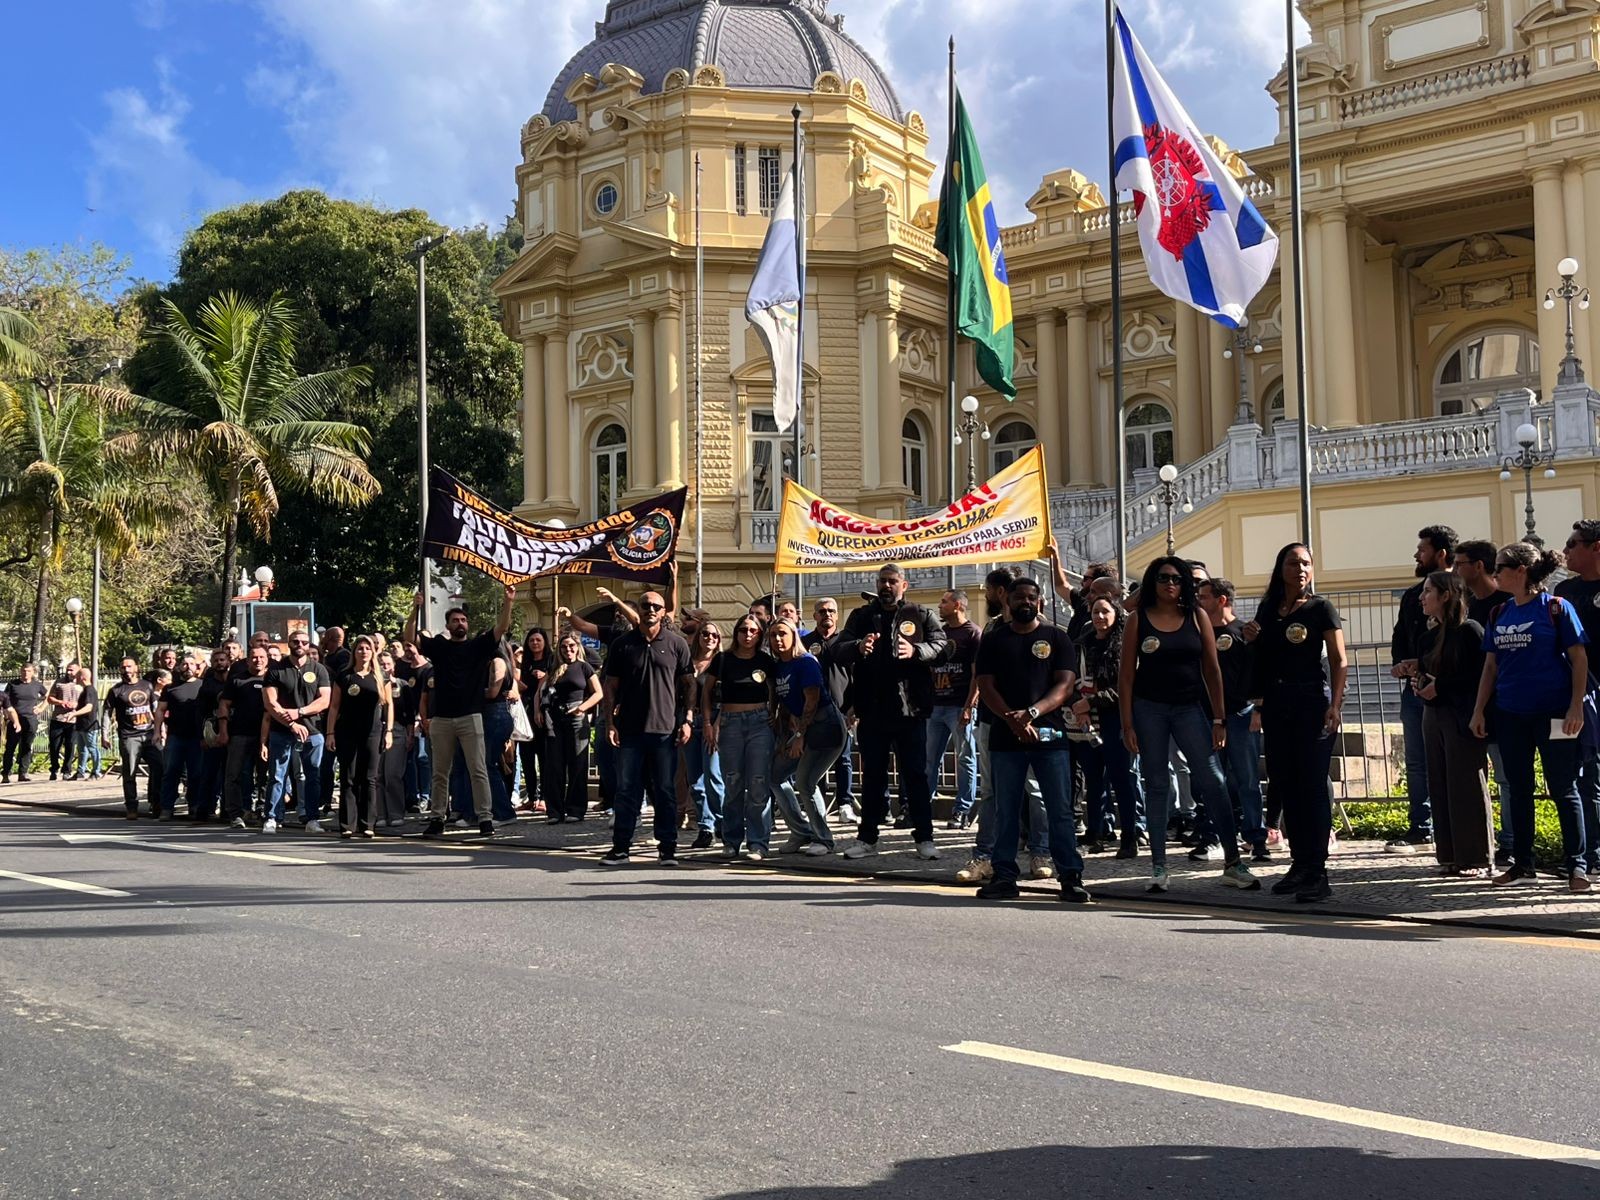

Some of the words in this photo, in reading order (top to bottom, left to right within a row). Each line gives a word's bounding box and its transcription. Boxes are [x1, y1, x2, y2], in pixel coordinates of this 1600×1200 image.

[453, 501, 511, 546] FALTA
[818, 530, 896, 549] QUEREMOS
[900, 501, 1000, 542] TRABALHAR!
[865, 545, 923, 558] APROVADOS
[973, 527, 1001, 541] PARA
[1002, 516, 1038, 533] SERVIR
[985, 540, 998, 551] DE
[1000, 536, 1026, 550] NÓS!
[565, 562, 592, 573] 2021
